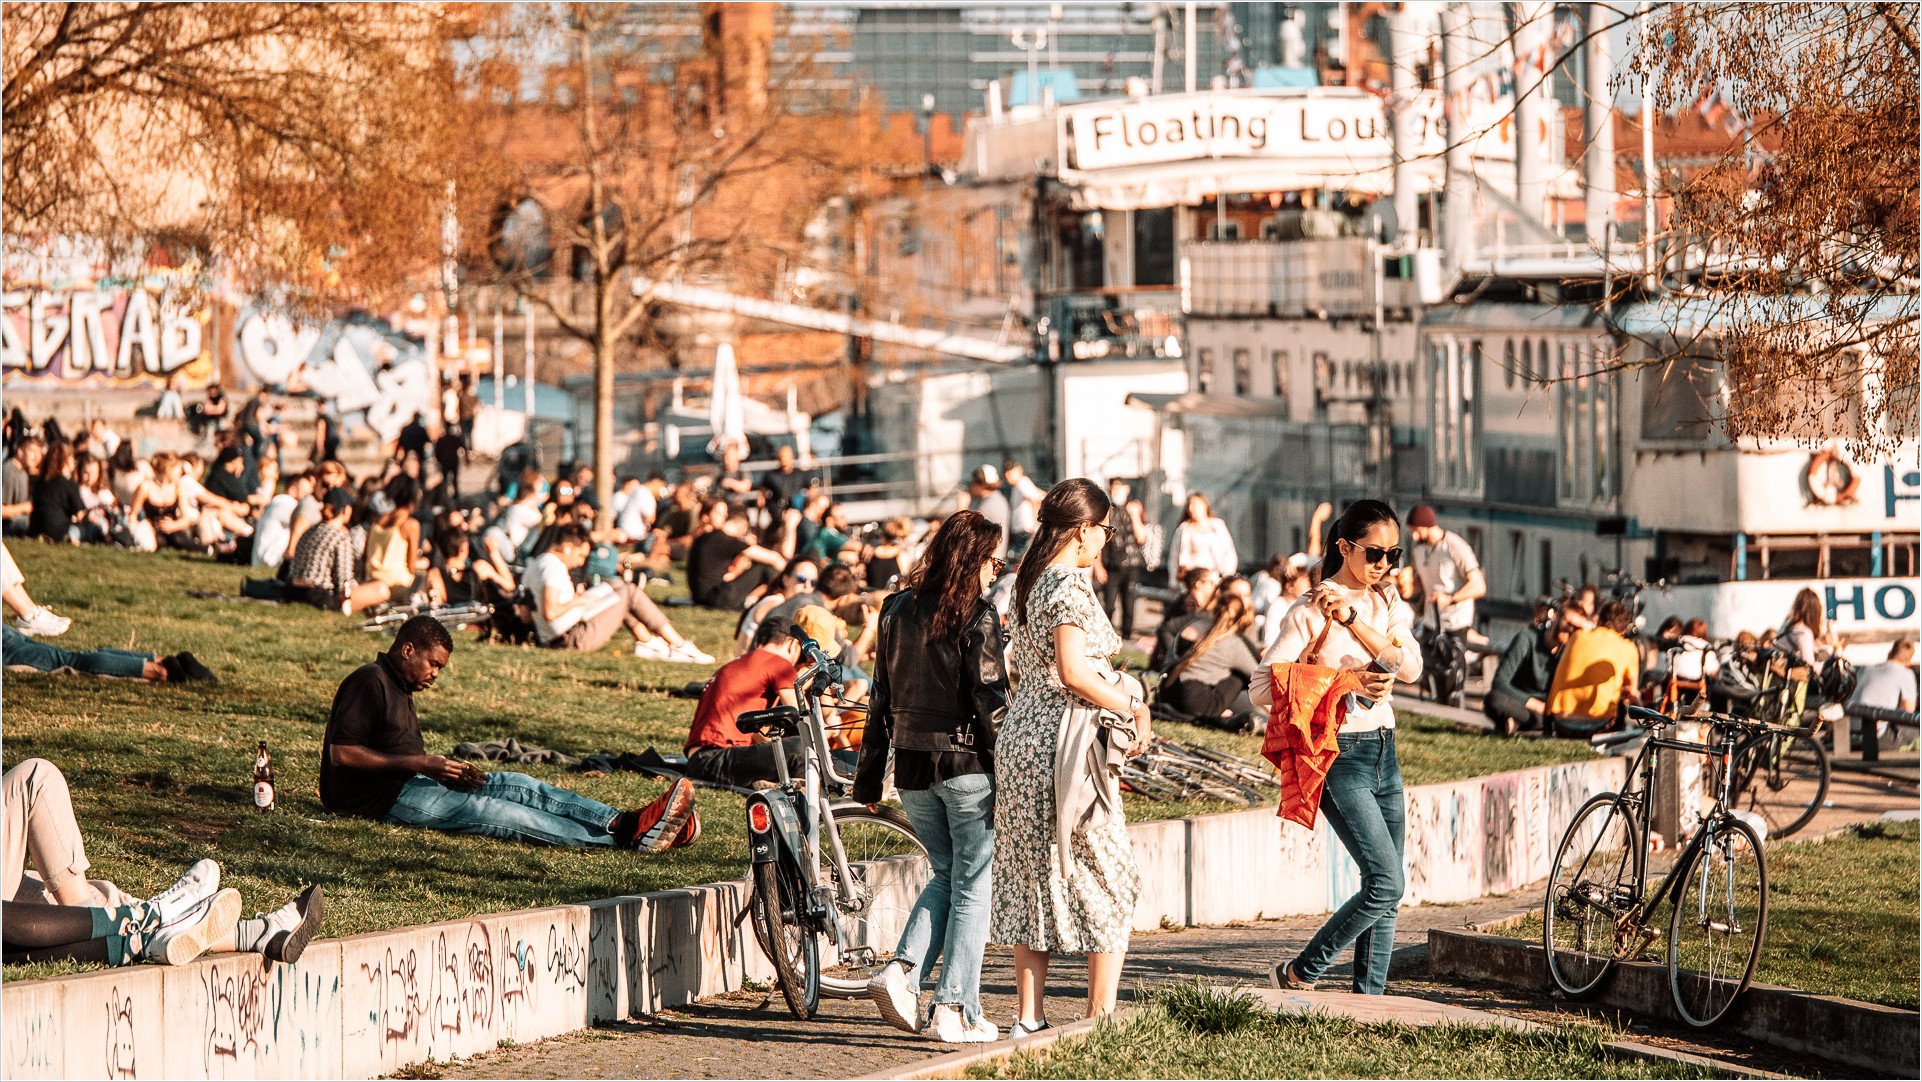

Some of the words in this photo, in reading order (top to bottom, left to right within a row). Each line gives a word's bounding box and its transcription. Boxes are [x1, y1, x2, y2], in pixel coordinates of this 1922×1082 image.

[1092, 103, 1268, 150] Floating
[1300, 107, 1447, 146] Louge
[1825, 585, 1916, 620] HO
